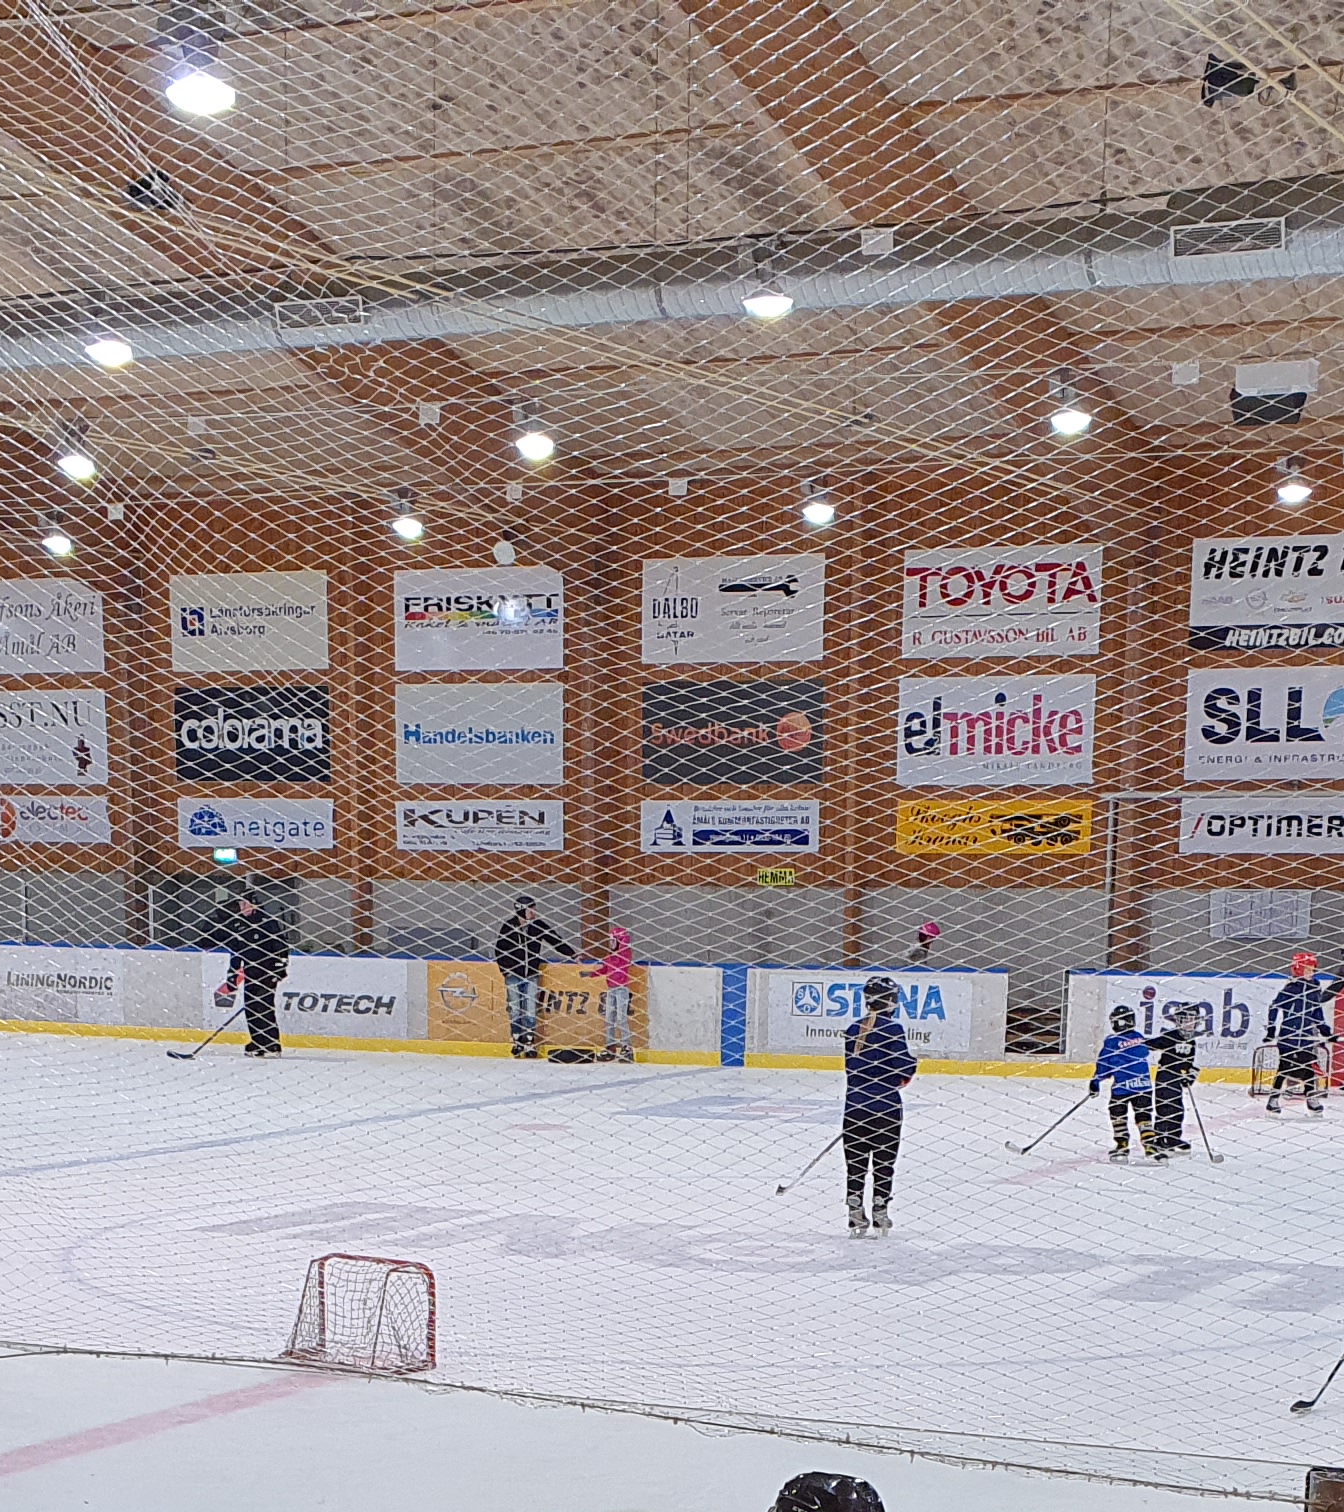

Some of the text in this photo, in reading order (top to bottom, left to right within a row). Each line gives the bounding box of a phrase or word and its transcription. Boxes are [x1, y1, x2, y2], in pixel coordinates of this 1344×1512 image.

[1203, 545, 1328, 579] HEINTZ
[906, 561, 1098, 608] TOYOTA
[652, 597, 698, 619] DALBO
[181, 708, 322, 748] colorama
[403, 723, 555, 745] Handelsbanken
[651, 722, 769, 746] Swedbank
[904, 692, 1083, 756] elmicke
[233, 818, 325, 842] netgate
[758, 870, 794, 885] HEMMA
[826, 983, 946, 1021] STNA
[806, 1026, 846, 1038] Innova
